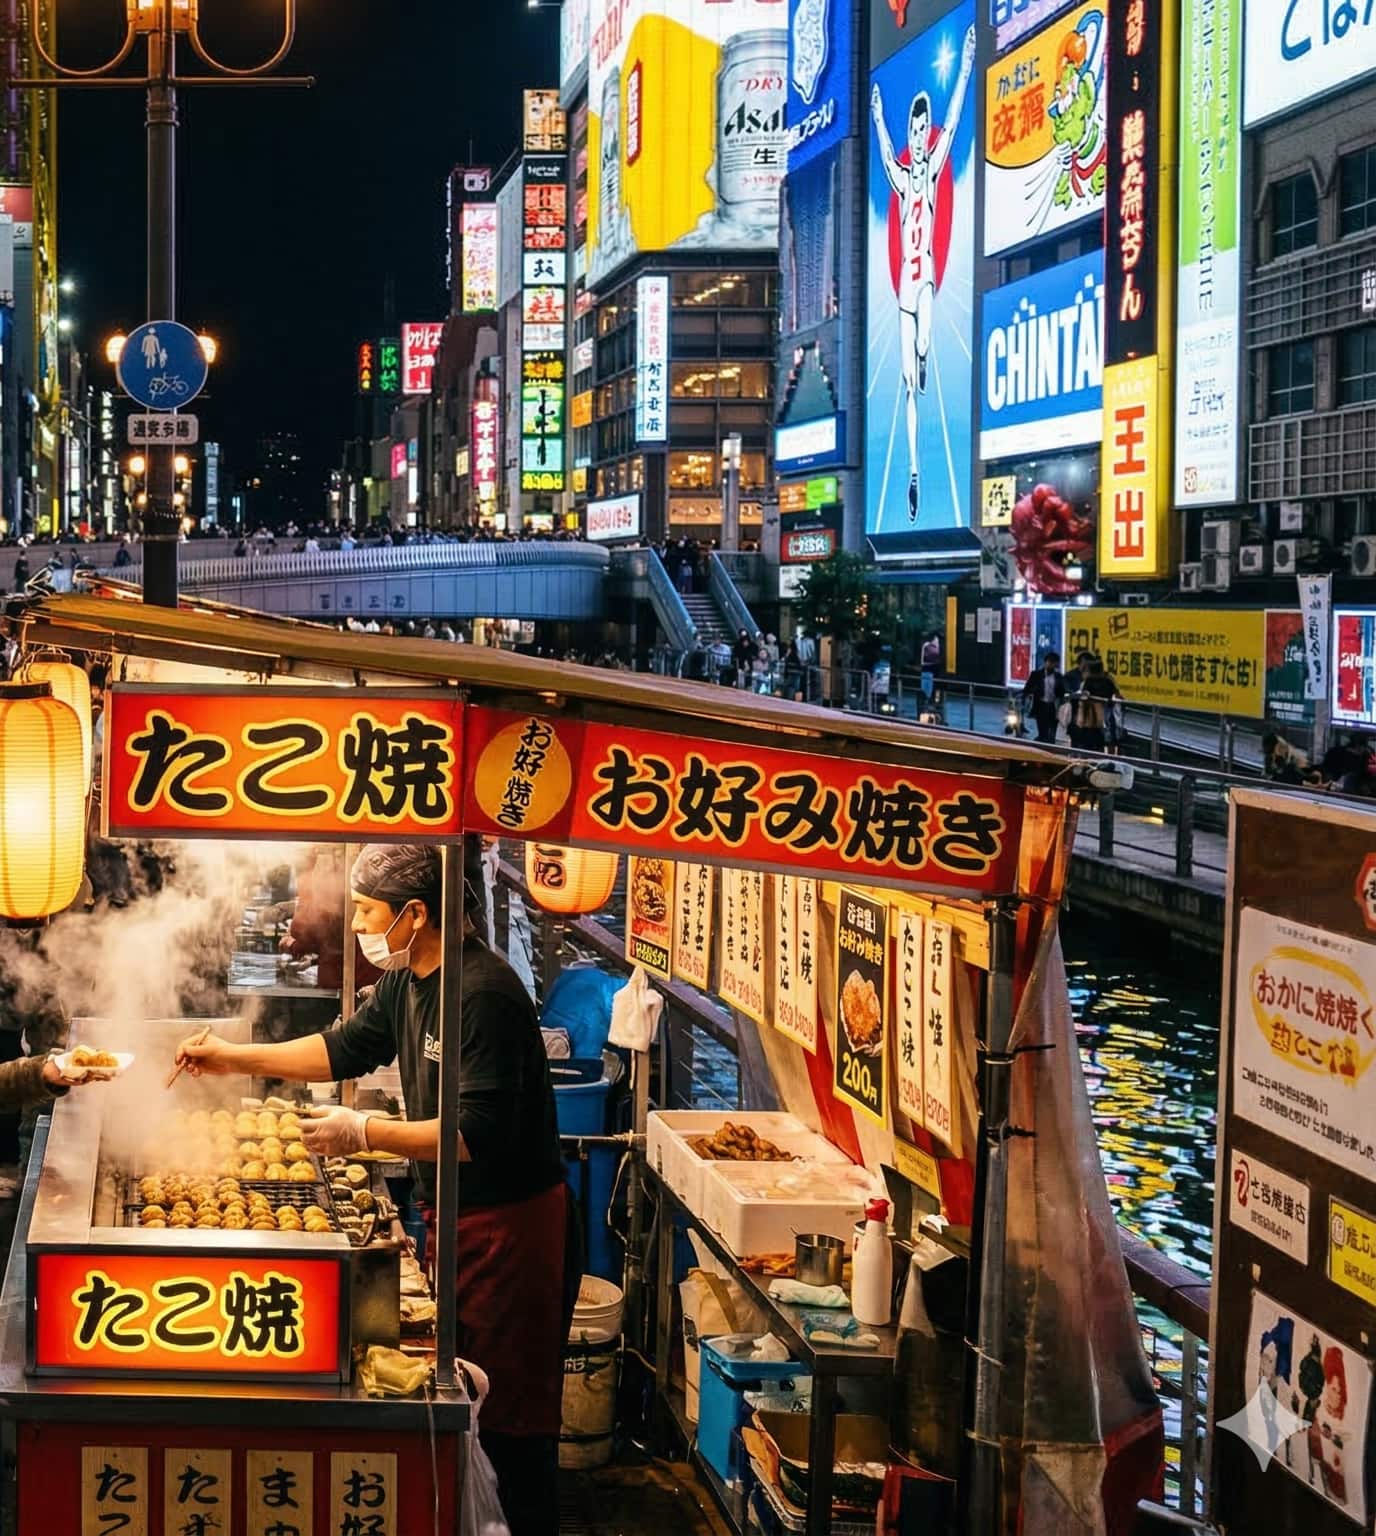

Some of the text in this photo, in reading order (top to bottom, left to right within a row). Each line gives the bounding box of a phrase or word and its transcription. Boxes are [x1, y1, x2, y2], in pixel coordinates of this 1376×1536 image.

[753, 147, 777, 165] 生
[1114, 405, 1145, 558] 王出
[131, 714, 450, 819] たこ焼
[593, 747, 1006, 873] お好み焼き
[842, 1052, 878, 1107] 200円
[77, 1275, 301, 1353] たこ焼
